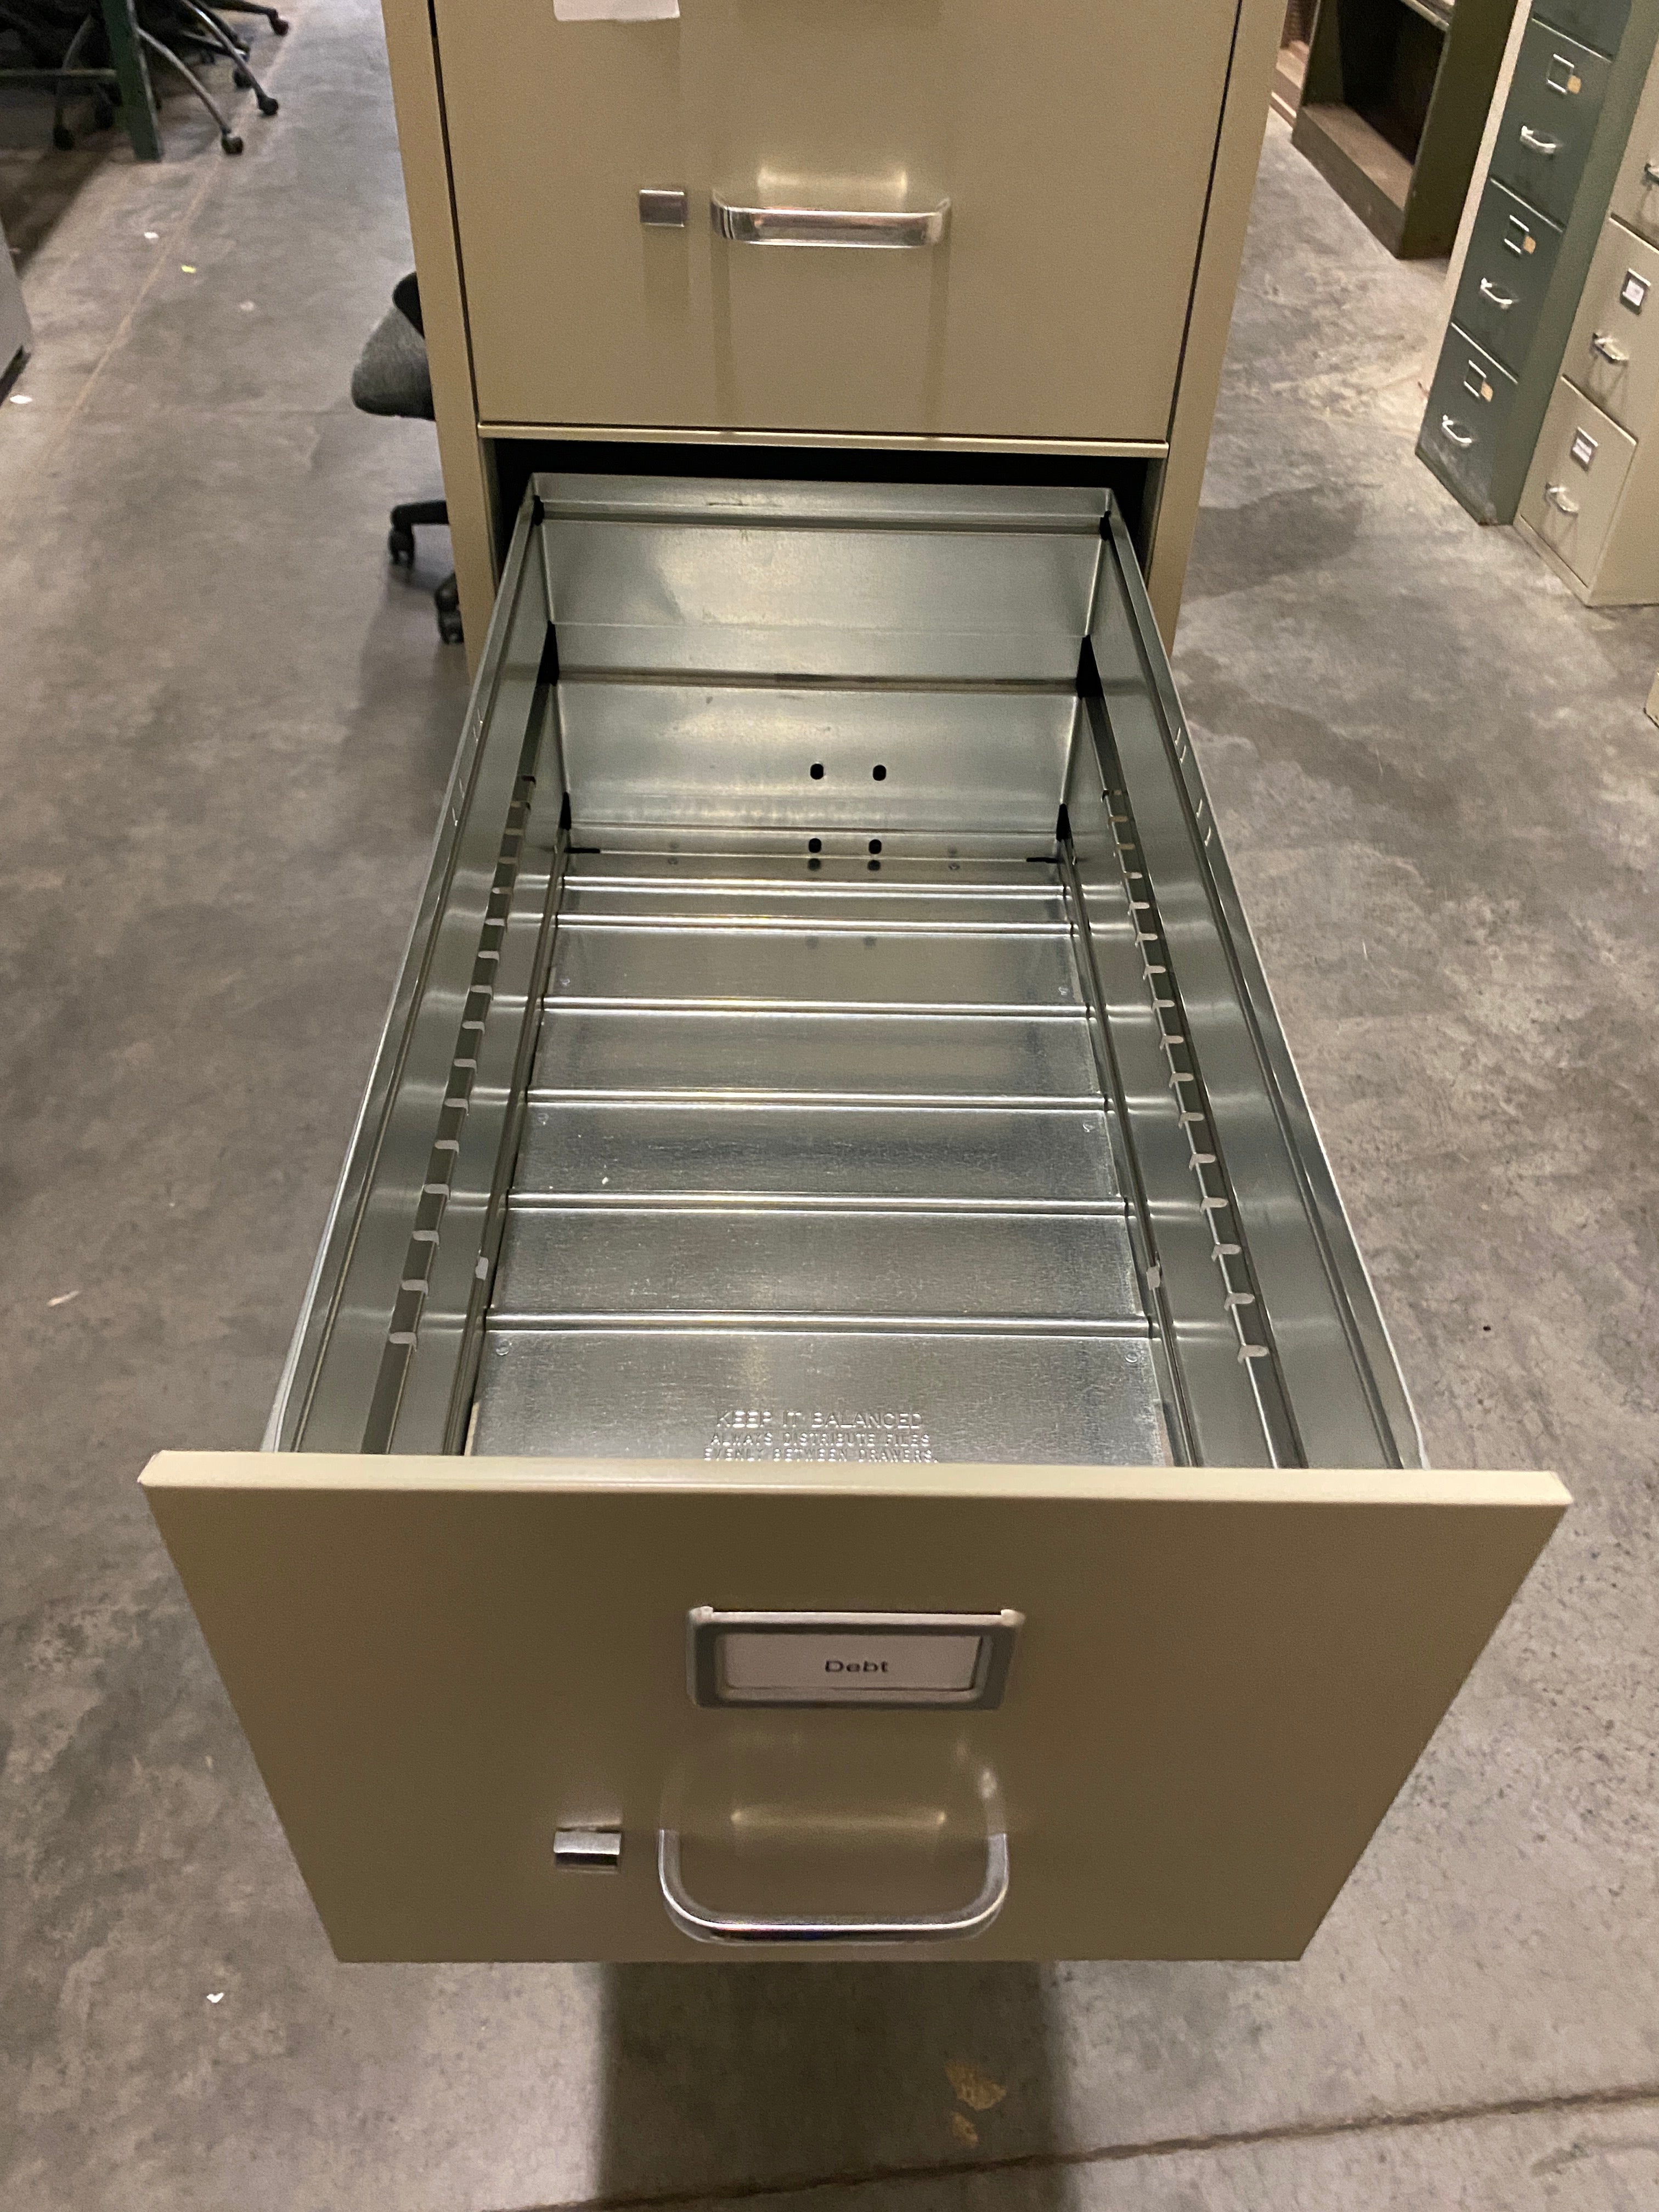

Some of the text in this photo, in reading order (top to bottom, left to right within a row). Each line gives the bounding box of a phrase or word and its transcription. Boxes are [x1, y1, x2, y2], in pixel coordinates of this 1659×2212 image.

[717, 1410, 923, 1429] KEEP IT BALANCED
[710, 1432, 930, 1448] ALWAYS DISTRIBUTE FILES
[704, 1448, 764, 1462] EVENLY
[774, 1448, 848, 1463] BETWEEN
[825, 1660, 888, 1673] Debt
